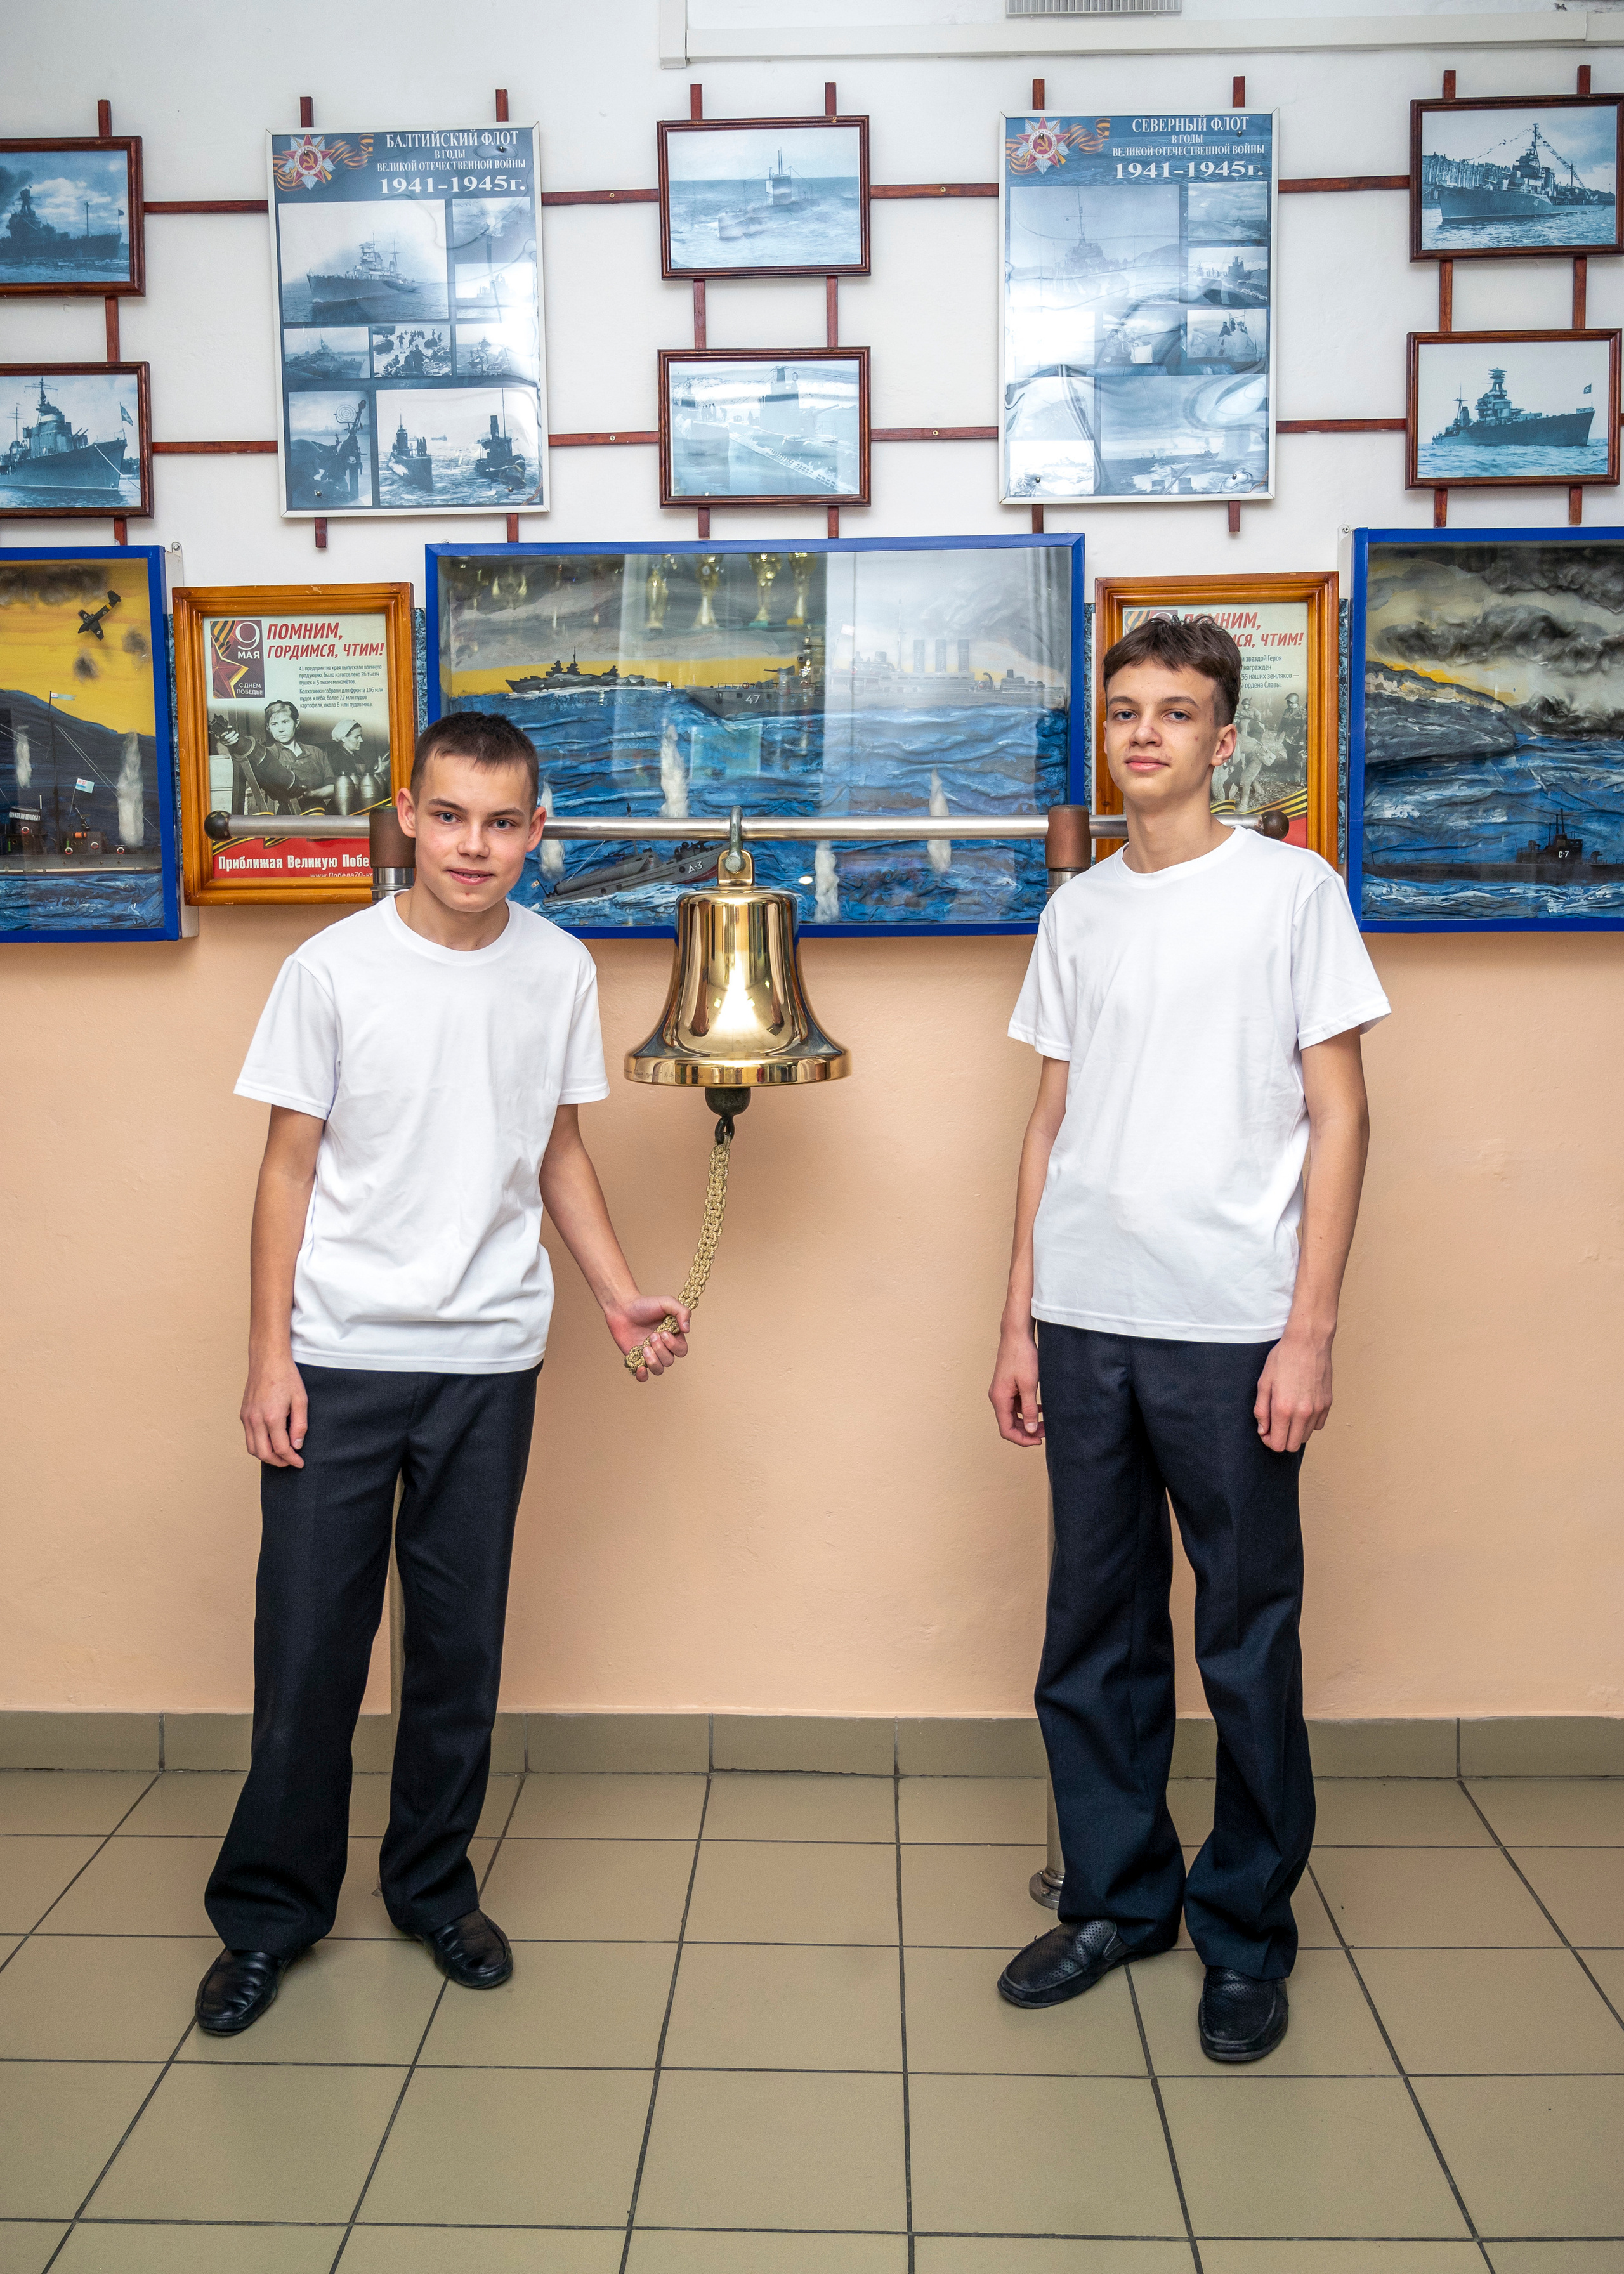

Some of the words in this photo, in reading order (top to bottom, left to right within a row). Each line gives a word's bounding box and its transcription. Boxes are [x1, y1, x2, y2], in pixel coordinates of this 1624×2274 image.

[1132, 115, 1207, 133] СЕВЕРНЫЙ
[1210, 117, 1249, 131] ФЛОТ
[386, 130, 478, 148] БАЛТИЙСКИЙ
[481, 131, 519, 145] ФЛОТ
[1172, 134, 1177, 143] В
[1179, 134, 1203, 144] ГОДЫ
[435, 150, 440, 159] В
[442, 149, 466, 159] ГОДЫ
[1113, 145, 1153, 157] ВЕЛИКОЙ
[1155, 143, 1230, 156] ОТЕЧЕСТВЕННОЙ
[1232, 143, 1264, 154] ВОЙНЫ
[377, 160, 417, 172] ВЕЛИКОЙ
[419, 158, 492, 171] ОТЕЧЕСТВЕННОЙ
[494, 157, 526, 169] ВОЙНЫ
[1115, 160, 1264, 179] 1941-1945г.
[379, 175, 526, 193] 1941-1945г.
[235, 622, 261, 650] 9
[266, 622, 343, 641] ПОМНИМ,
[1261, 632, 1304, 646] ЧТИМ!
[237, 651, 260, 659] МАЯ
[267, 643, 339, 660] ГОРДИМСЯ,
[343, 643, 385, 657] ЧТИМ!
[745, 694, 761, 704] 47
[218, 856, 283, 872] Приближая
[287, 854, 338, 870] Великую
[343, 854, 370, 868] Побе
